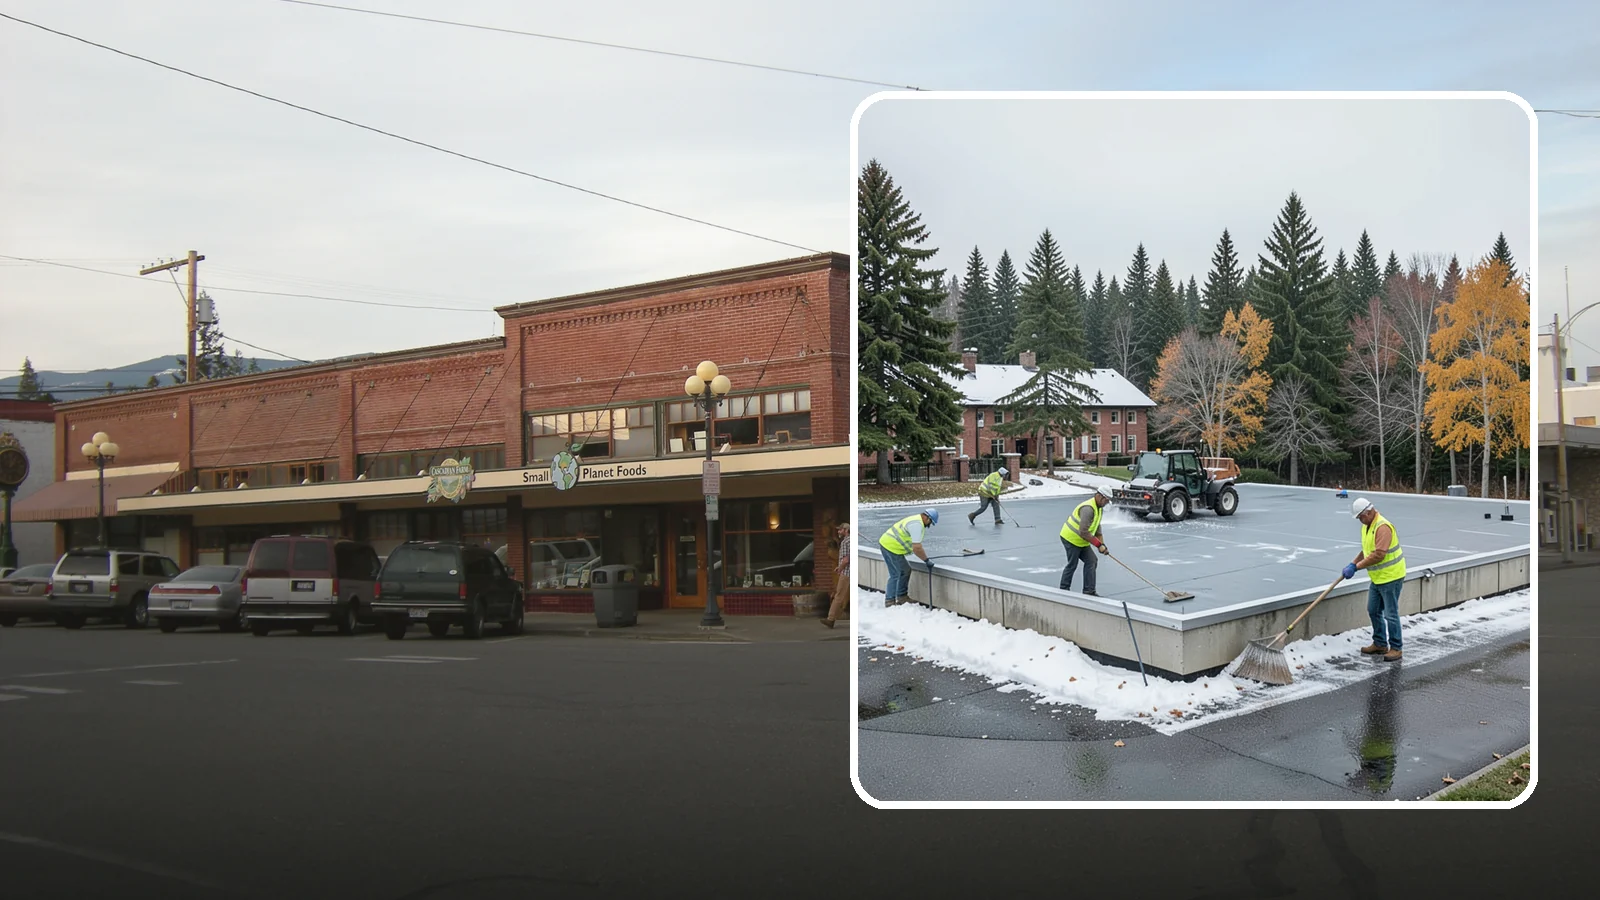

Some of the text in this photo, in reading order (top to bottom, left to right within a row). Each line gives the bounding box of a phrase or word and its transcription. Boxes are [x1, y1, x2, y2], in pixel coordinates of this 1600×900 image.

[431, 466, 469, 476] CASCADIAN FARM
[523, 464, 647, 483] Small Planet Foods
